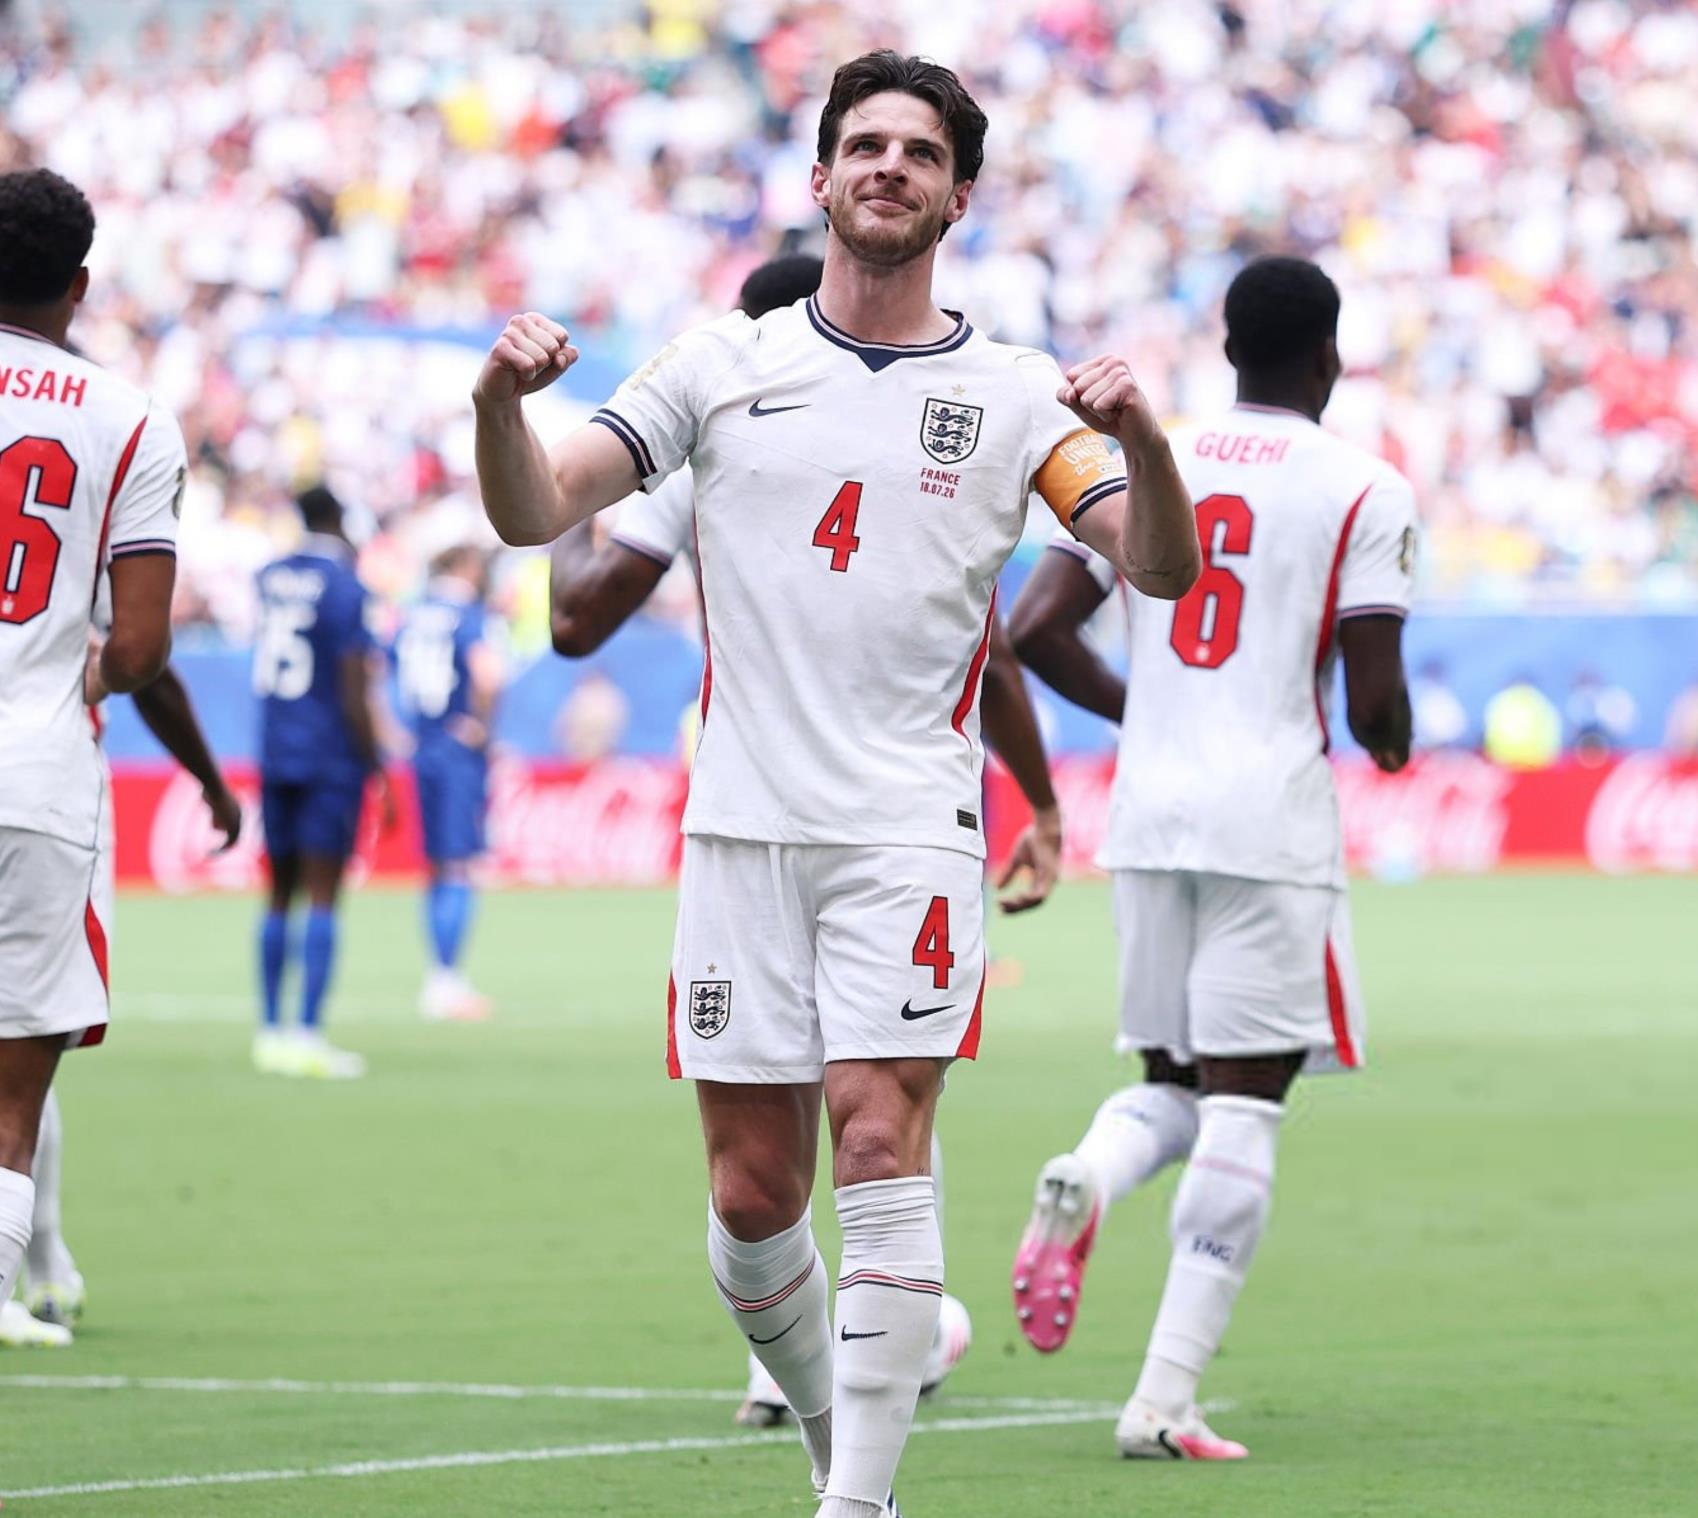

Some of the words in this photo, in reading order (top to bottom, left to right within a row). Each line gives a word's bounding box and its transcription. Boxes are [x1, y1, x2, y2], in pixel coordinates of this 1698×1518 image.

[920, 467, 961, 486] FRANCE
[920, 481, 956, 499] 18.07.26
[0, 435, 79, 625] 6
[812, 480, 864, 572] 4
[1170, 493, 1255, 670] 6
[912, 895, 955, 989] 4
